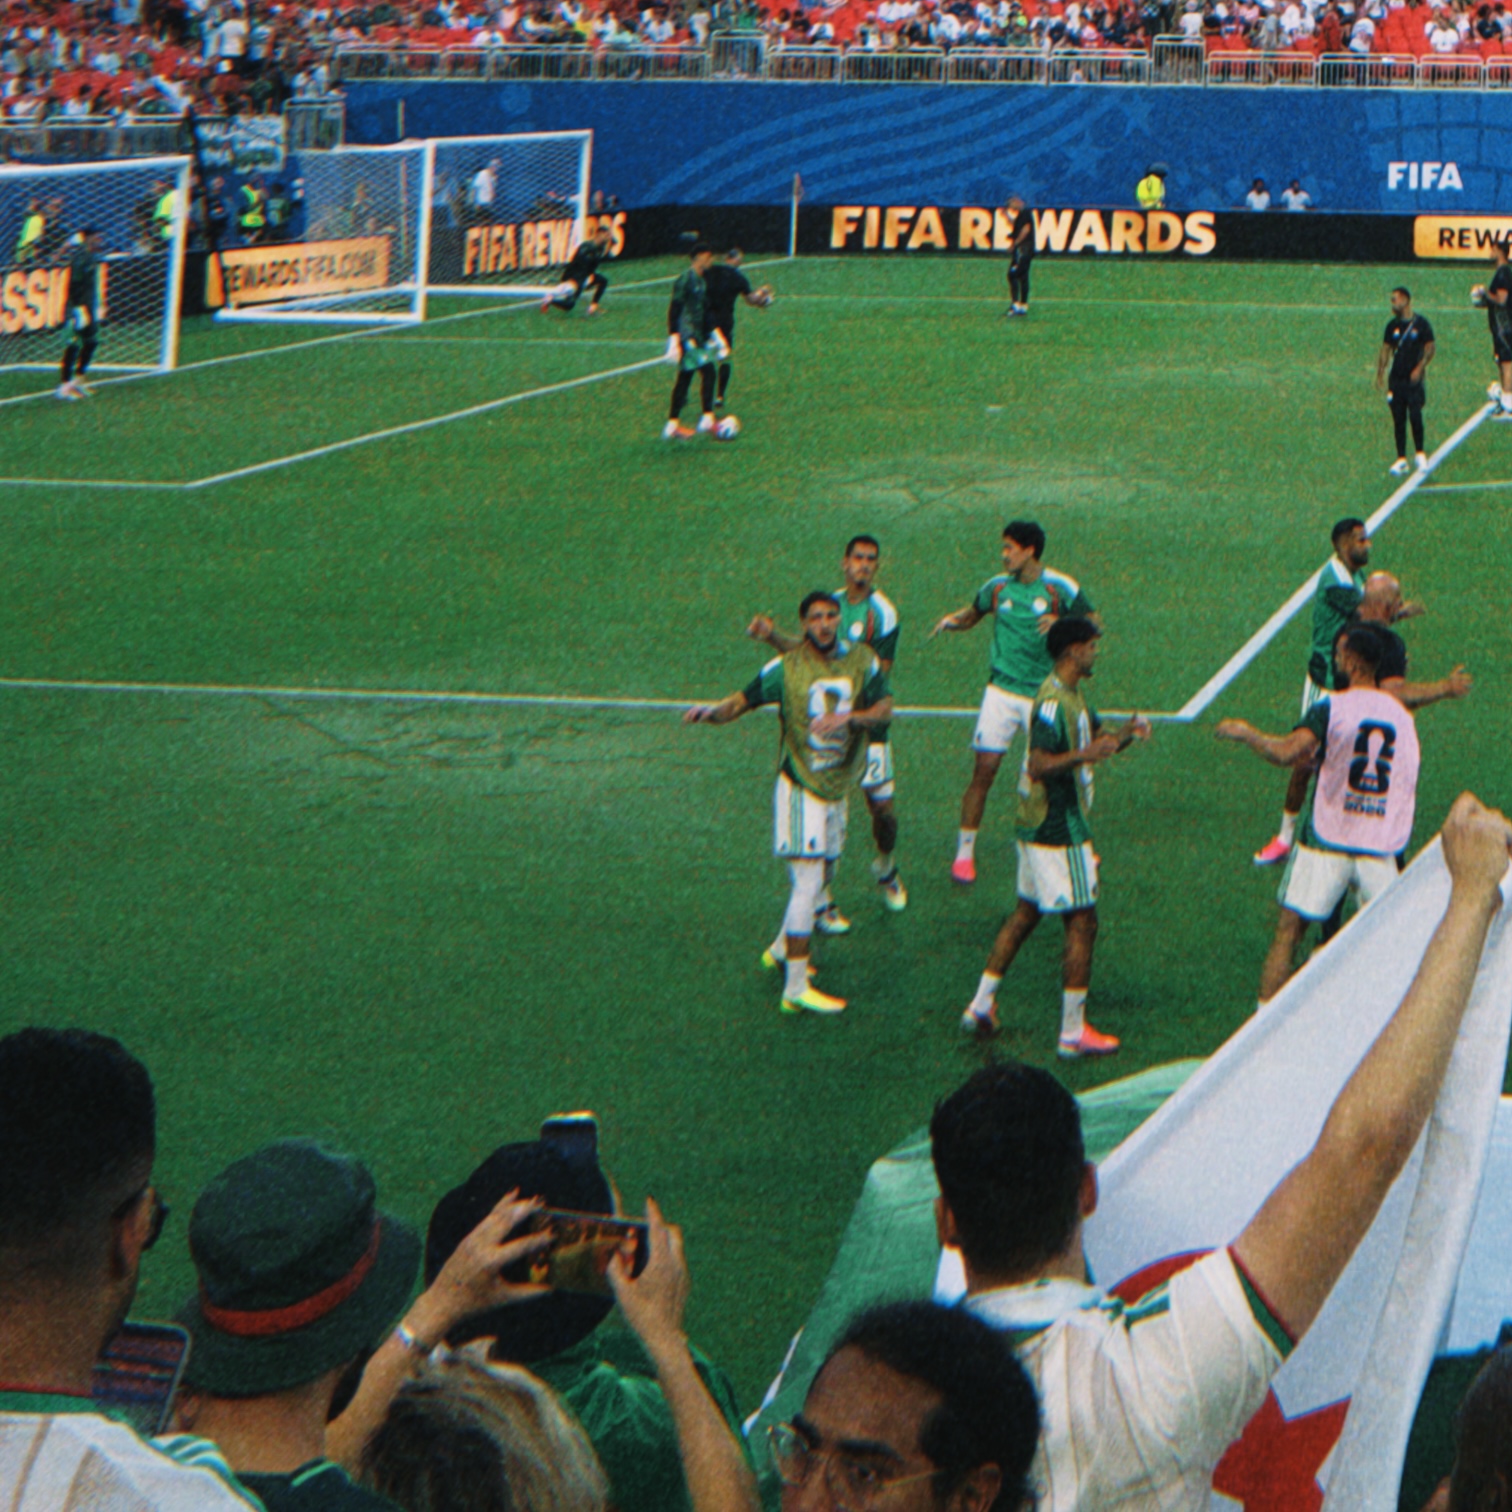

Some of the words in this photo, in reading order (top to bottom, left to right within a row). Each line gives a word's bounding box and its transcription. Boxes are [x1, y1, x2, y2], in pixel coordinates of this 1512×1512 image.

[1387, 162, 1463, 190] FIFA
[464, 223, 517, 276] FIFA
[830, 206, 948, 249] FIFA
[957, 207, 1217, 255] REWARDS
